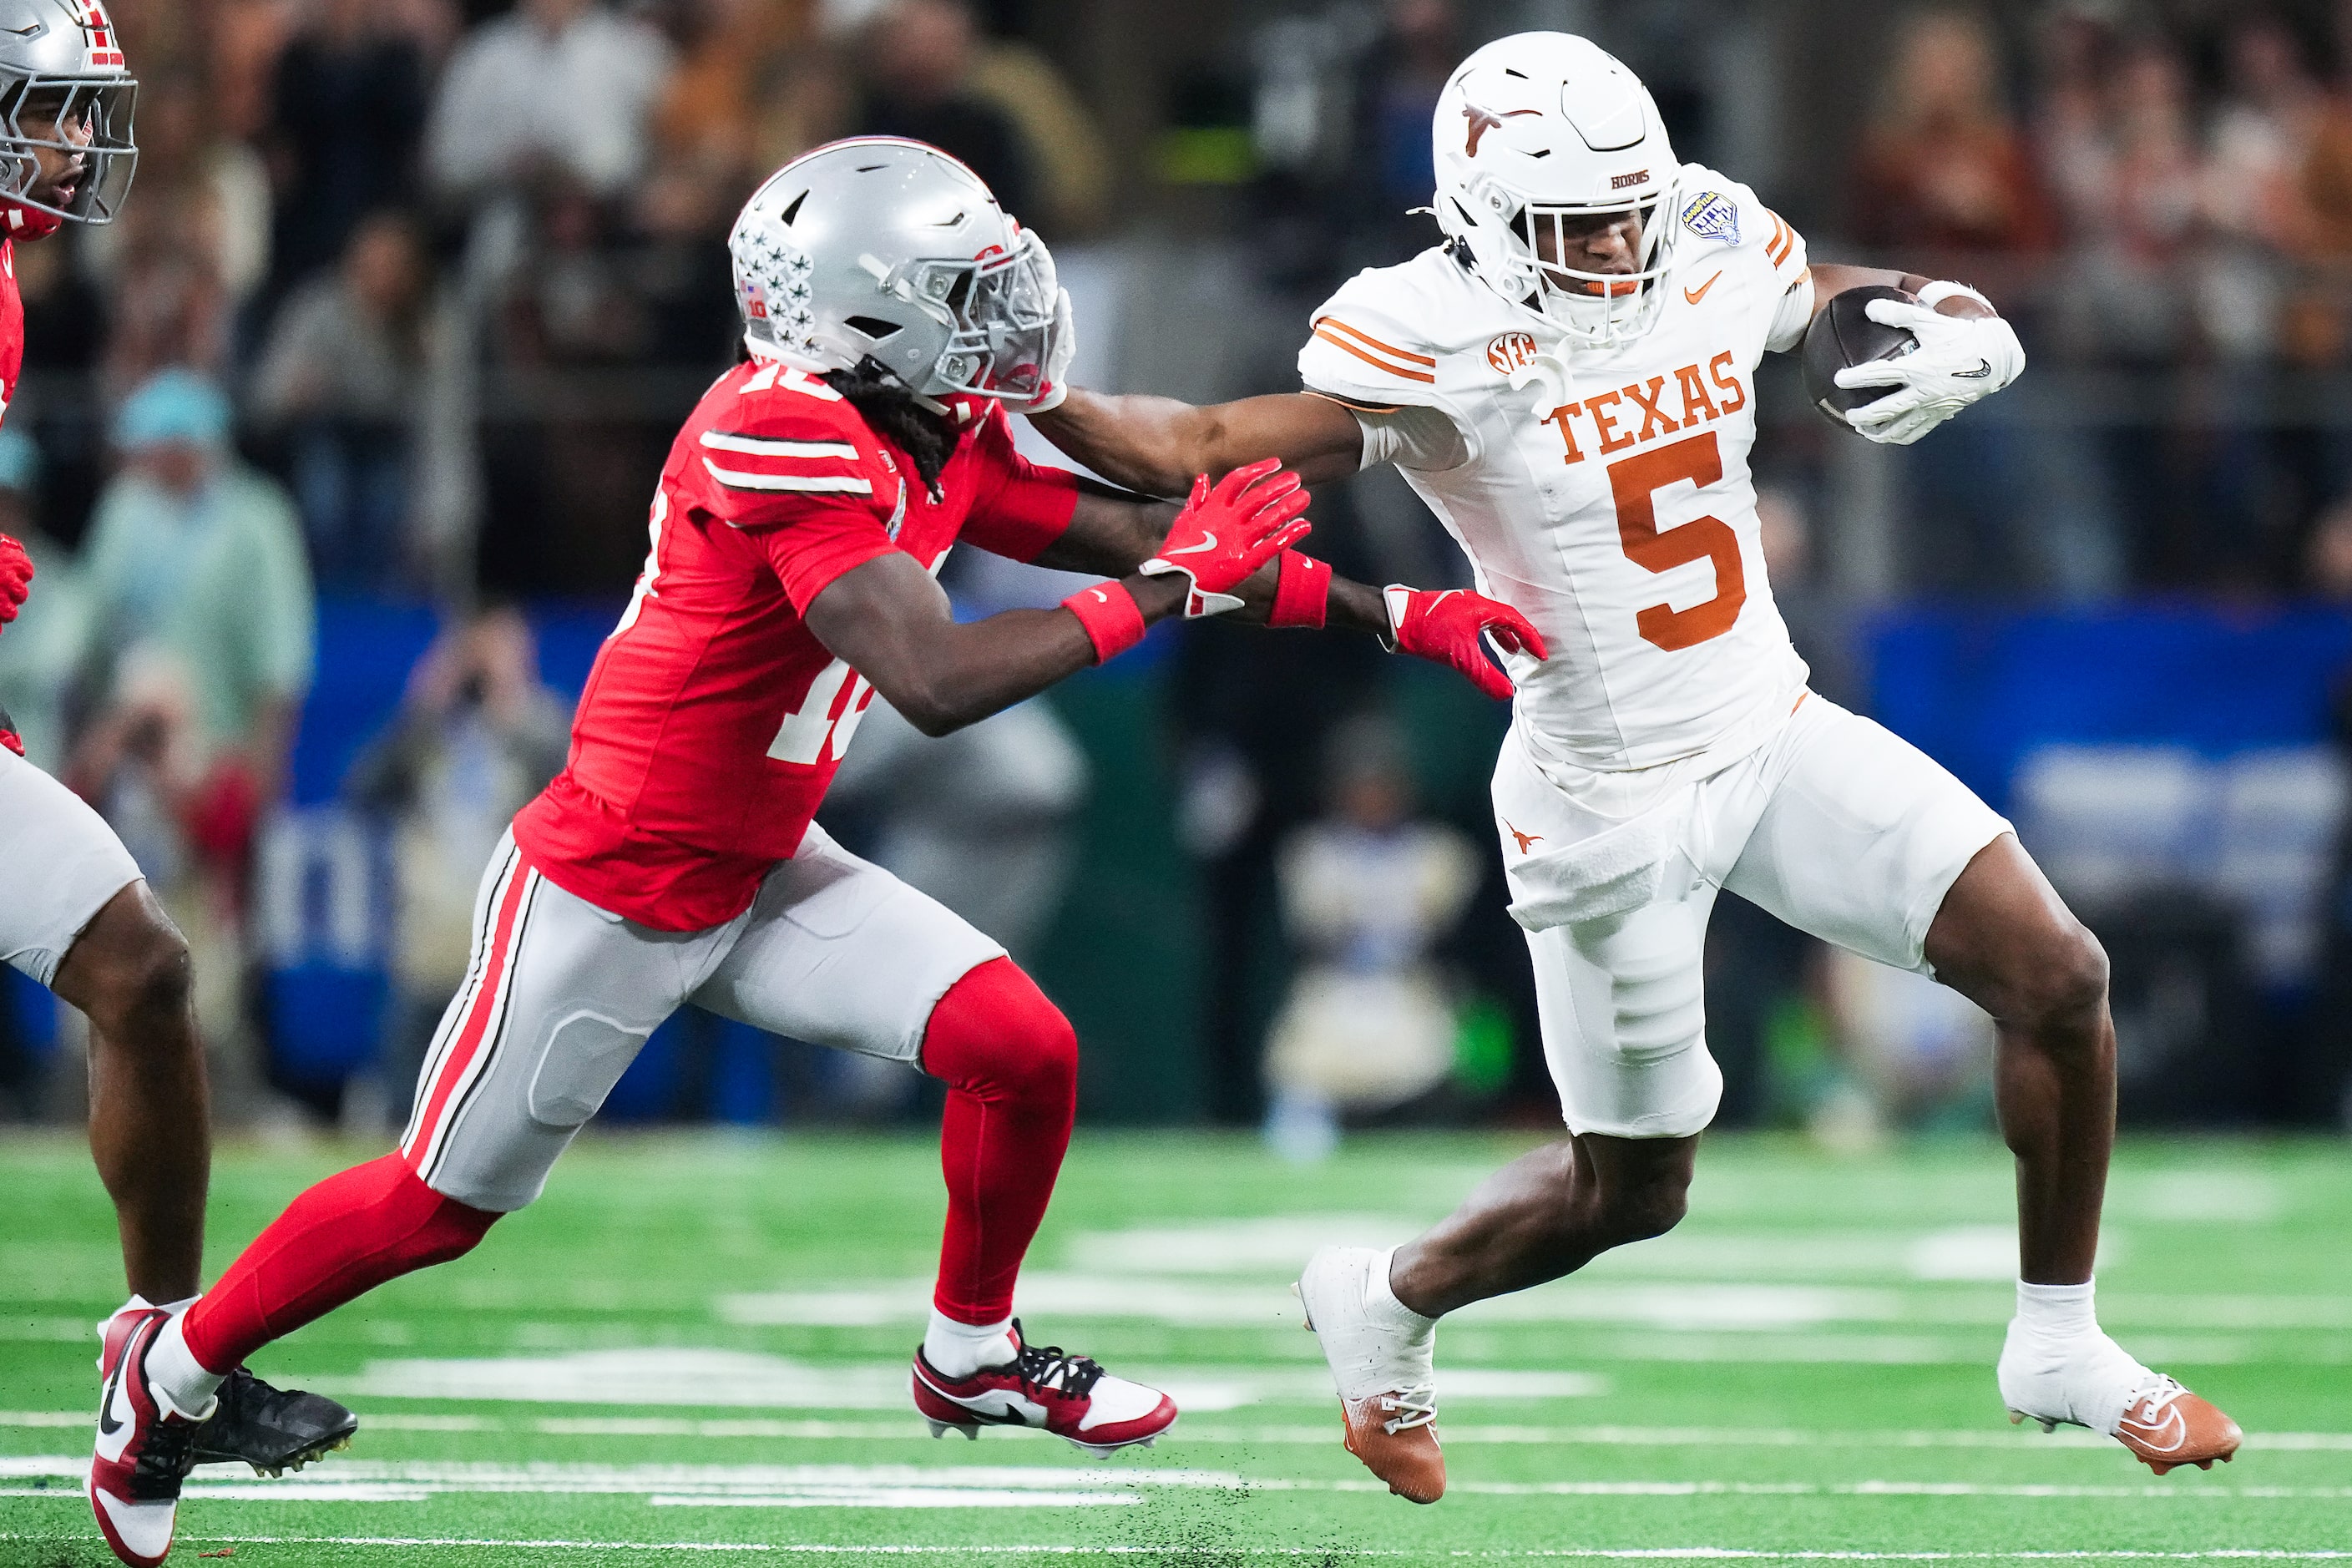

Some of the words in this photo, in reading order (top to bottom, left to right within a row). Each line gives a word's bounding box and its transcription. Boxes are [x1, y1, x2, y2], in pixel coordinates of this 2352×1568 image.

[1611, 169, 1650, 190] HORNS
[748, 300, 767, 318] 10
[1540, 350, 1745, 464] TEXAS
[1606, 431, 1747, 652] 5
